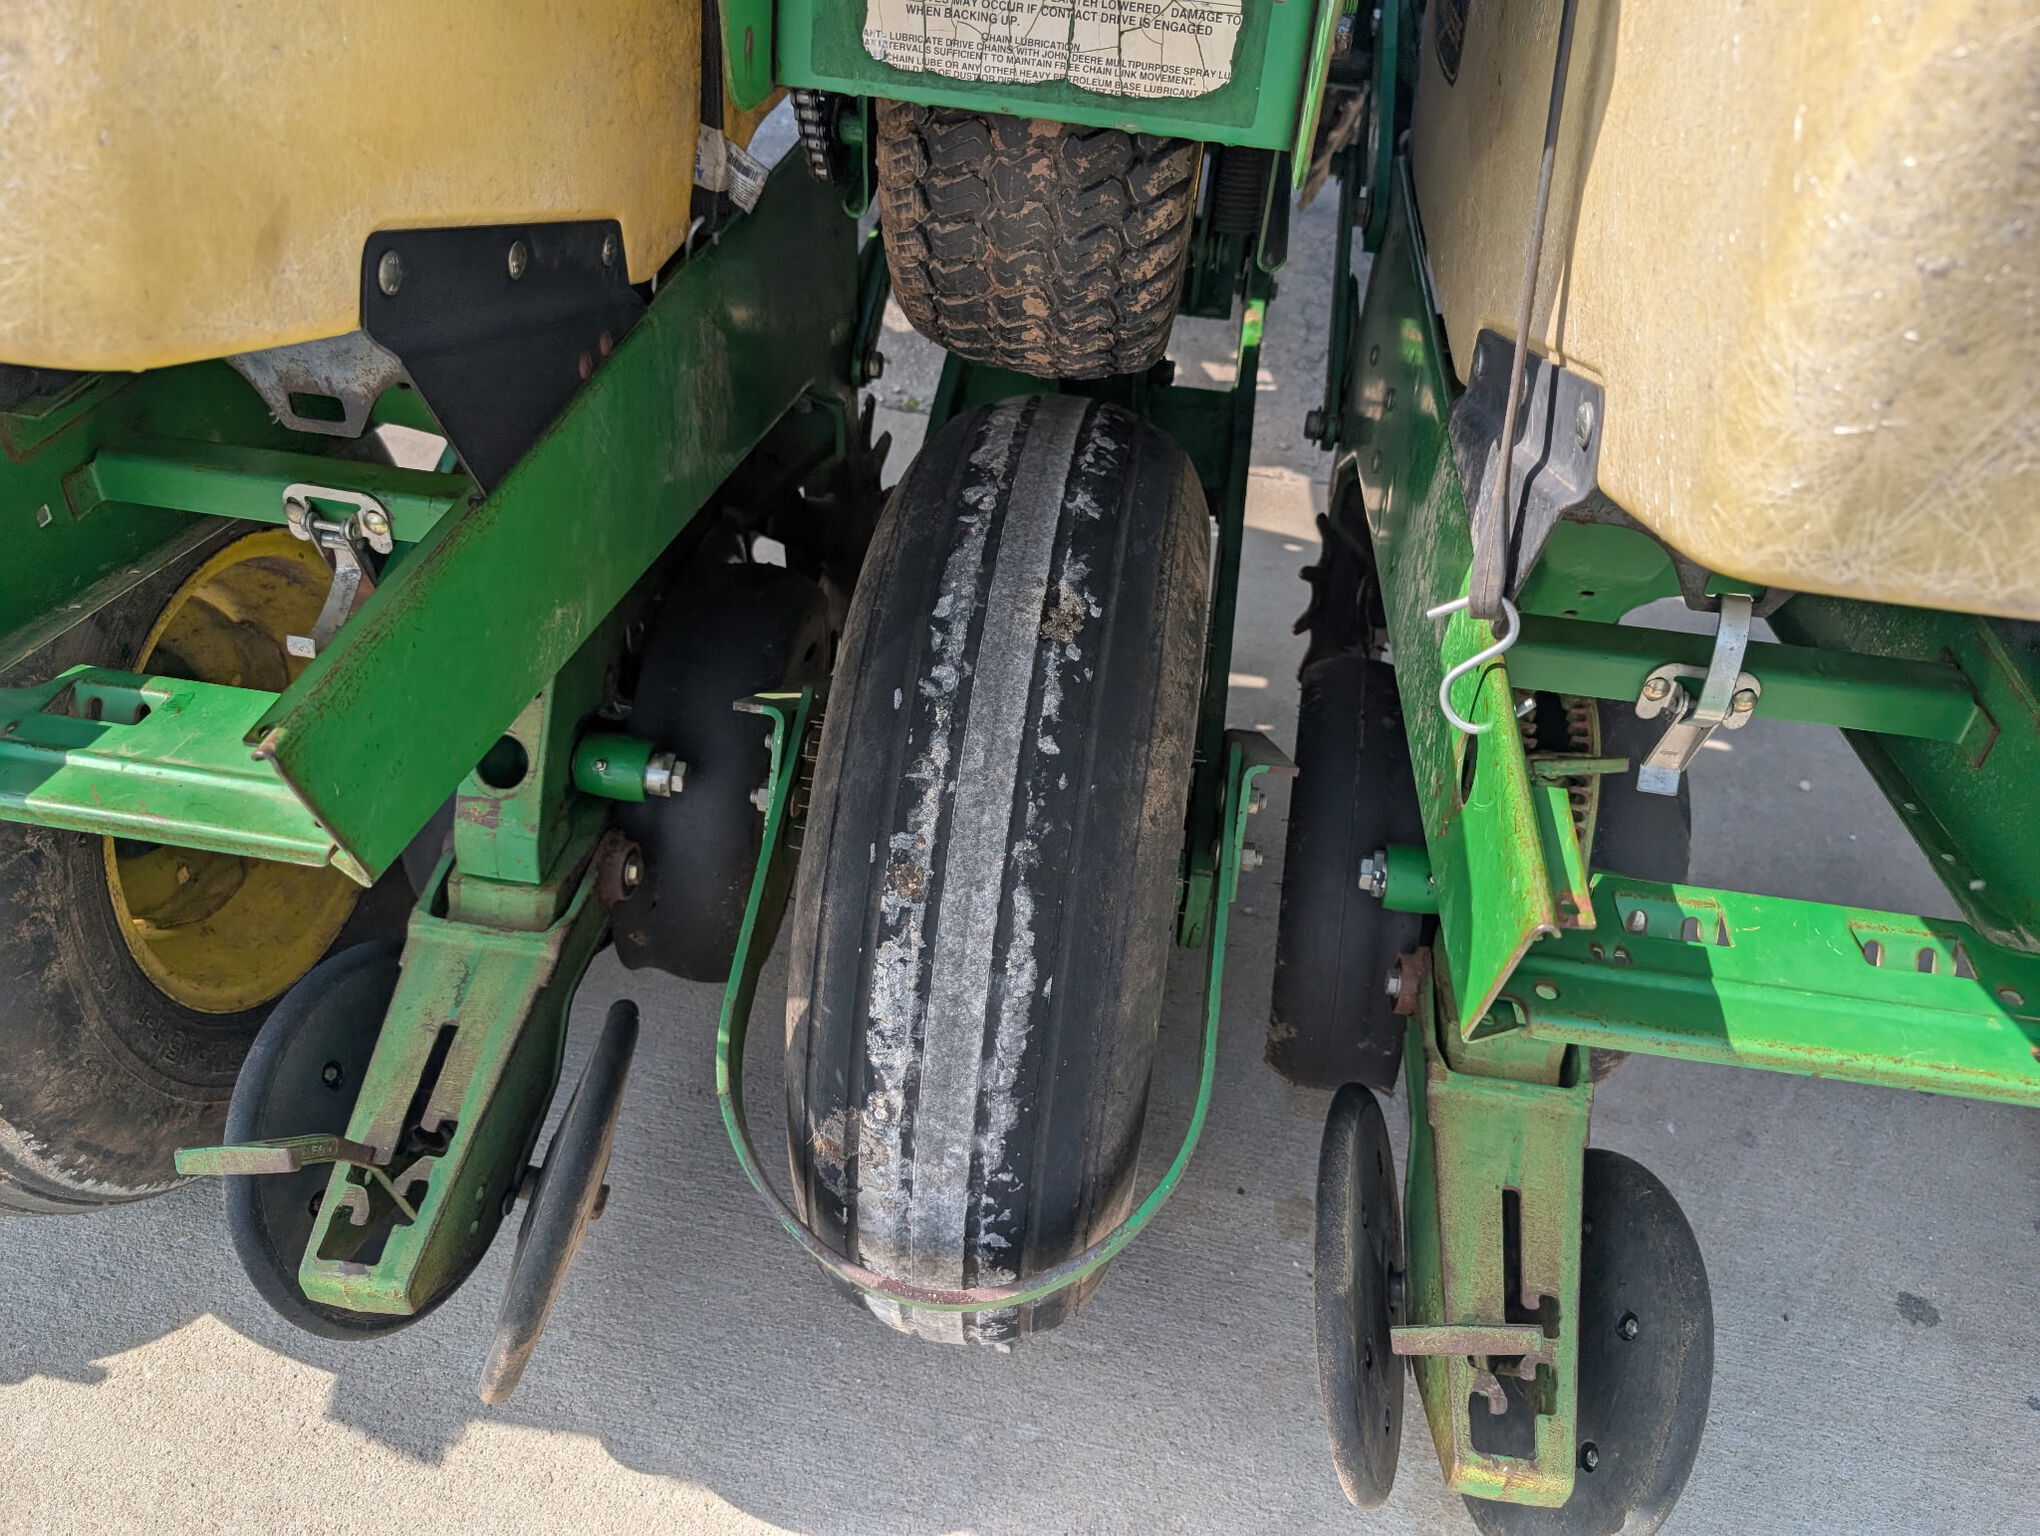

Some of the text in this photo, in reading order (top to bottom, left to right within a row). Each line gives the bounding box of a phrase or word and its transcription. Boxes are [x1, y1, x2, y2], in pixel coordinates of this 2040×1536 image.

[906, 4, 1020, 26] WHEN BACKING UP.
[982, 0, 1024, 13] OCCUR
[1027, 4, 1037, 14] IF
[1041, 7, 1098, 21] CONTACT
[1100, 13, 1136, 26] DRIVE
[1140, 16, 1150, 28] IS
[1154, 20, 1213, 36] ENGAGED
[1171, 8, 1222, 23] DAMAGE
[1227, 14, 1241, 26] TO
[890, 32, 943, 46] LUBRICATE
[946, 39, 974, 49] DRIVE
[976, 42, 1013, 54] CHAINS
[1016, 47, 1040, 57] WITH
[1042, 51, 1068, 60] JOHN
[1072, 54, 1103, 65] DEERE
[1105, 58, 1181, 75] MULTIPURPOSE
[1183, 67, 1216, 78] SPRAY
[982, 33, 1080, 52] CHAIN LUBRICATION
[917, 58, 942, 67] LUBE
[945, 60, 959, 69] OR
[962, 63, 980, 72] ANY
[984, 65, 1016, 76] OTHER
[1020, 68, 1051, 80] HEAVY
[1115, 81, 1141, 91] BASE
[1143, 84, 1198, 97] LUBRICANT
[934, 47, 989, 60] SUFFICIENT
[992, 53, 1004, 63] TO
[1006, 56, 1052, 68] MAINTAIN
[1054, 61, 1081, 72] FREE
[1082, 65, 1112, 76] CHAIN
[1114, 69, 1137, 79] LINK
[1139, 71, 1196, 86] MOVEMENT.
